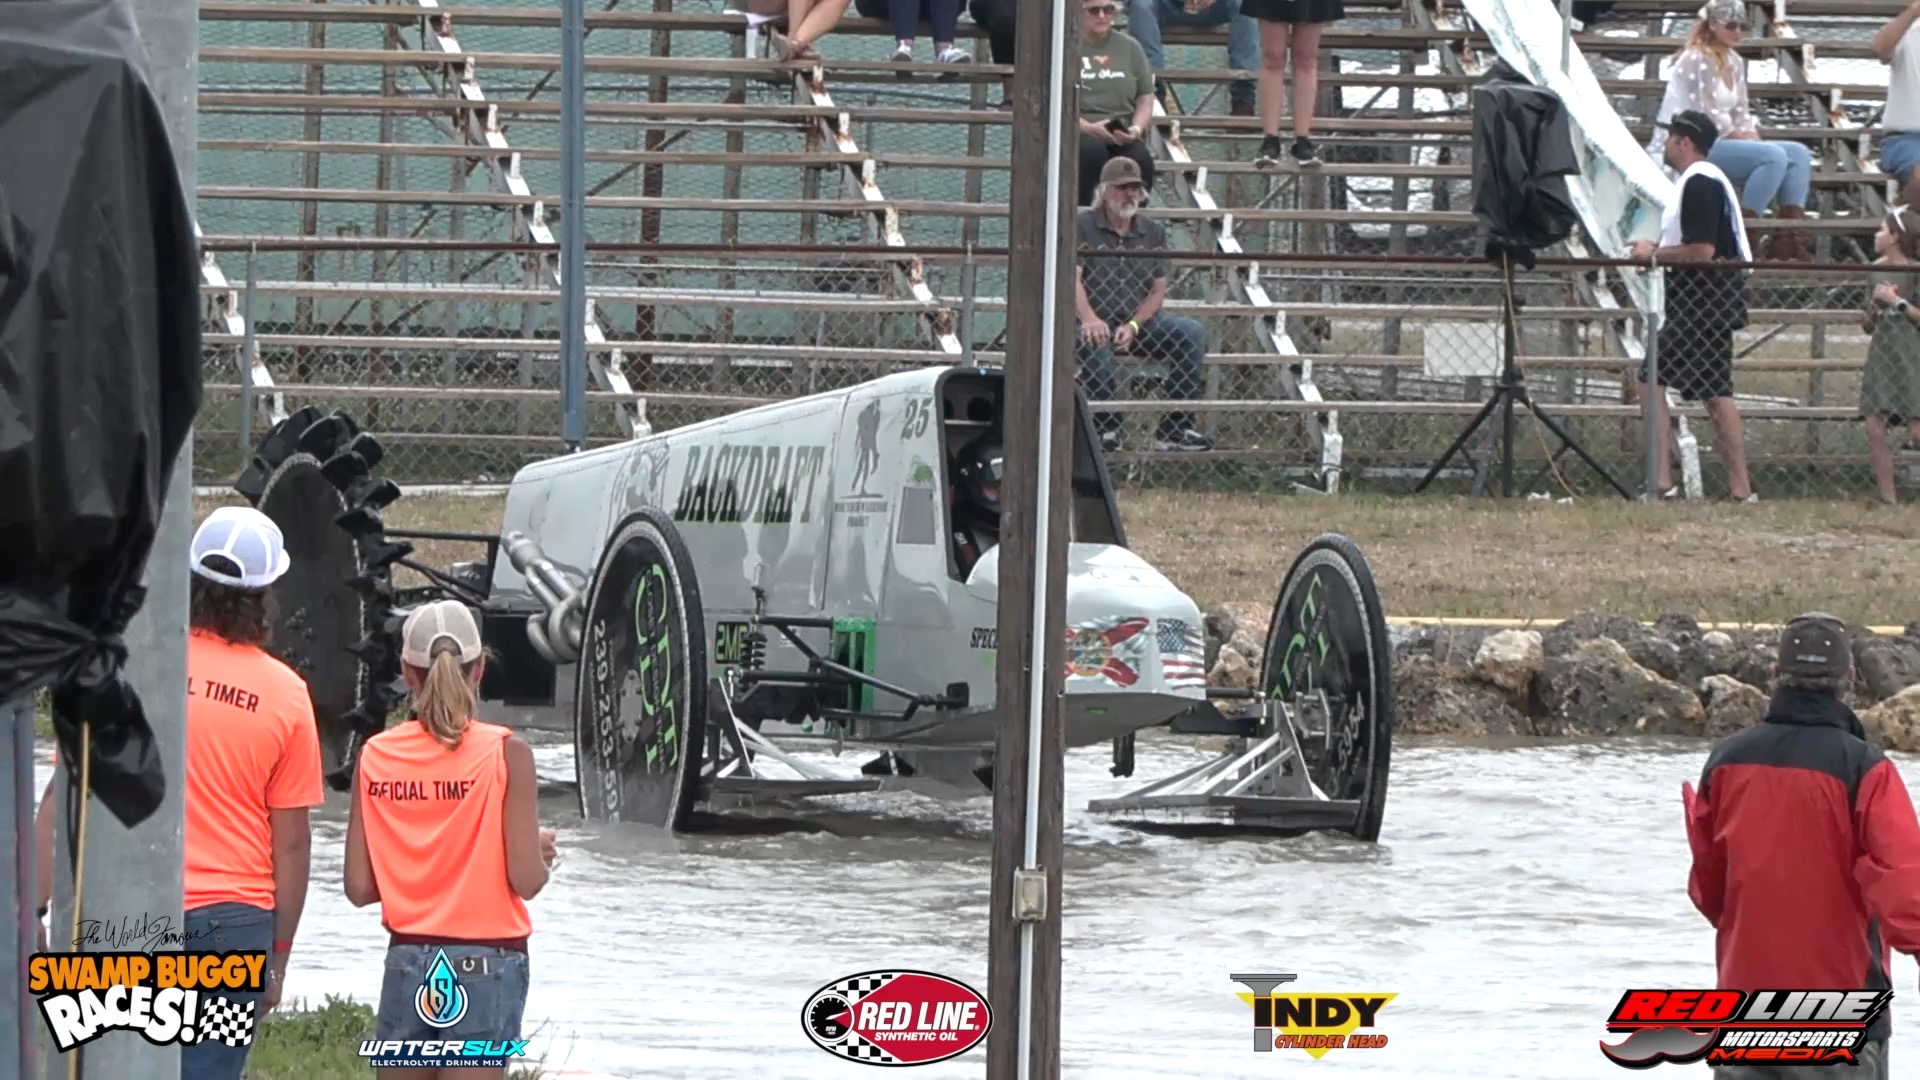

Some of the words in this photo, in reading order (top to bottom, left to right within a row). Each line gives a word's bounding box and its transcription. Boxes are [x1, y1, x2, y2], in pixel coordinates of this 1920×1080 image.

[901, 398, 932, 440] 25
[673, 445, 827, 525] BACKDRAFT
[205, 680, 260, 713] TIMER
